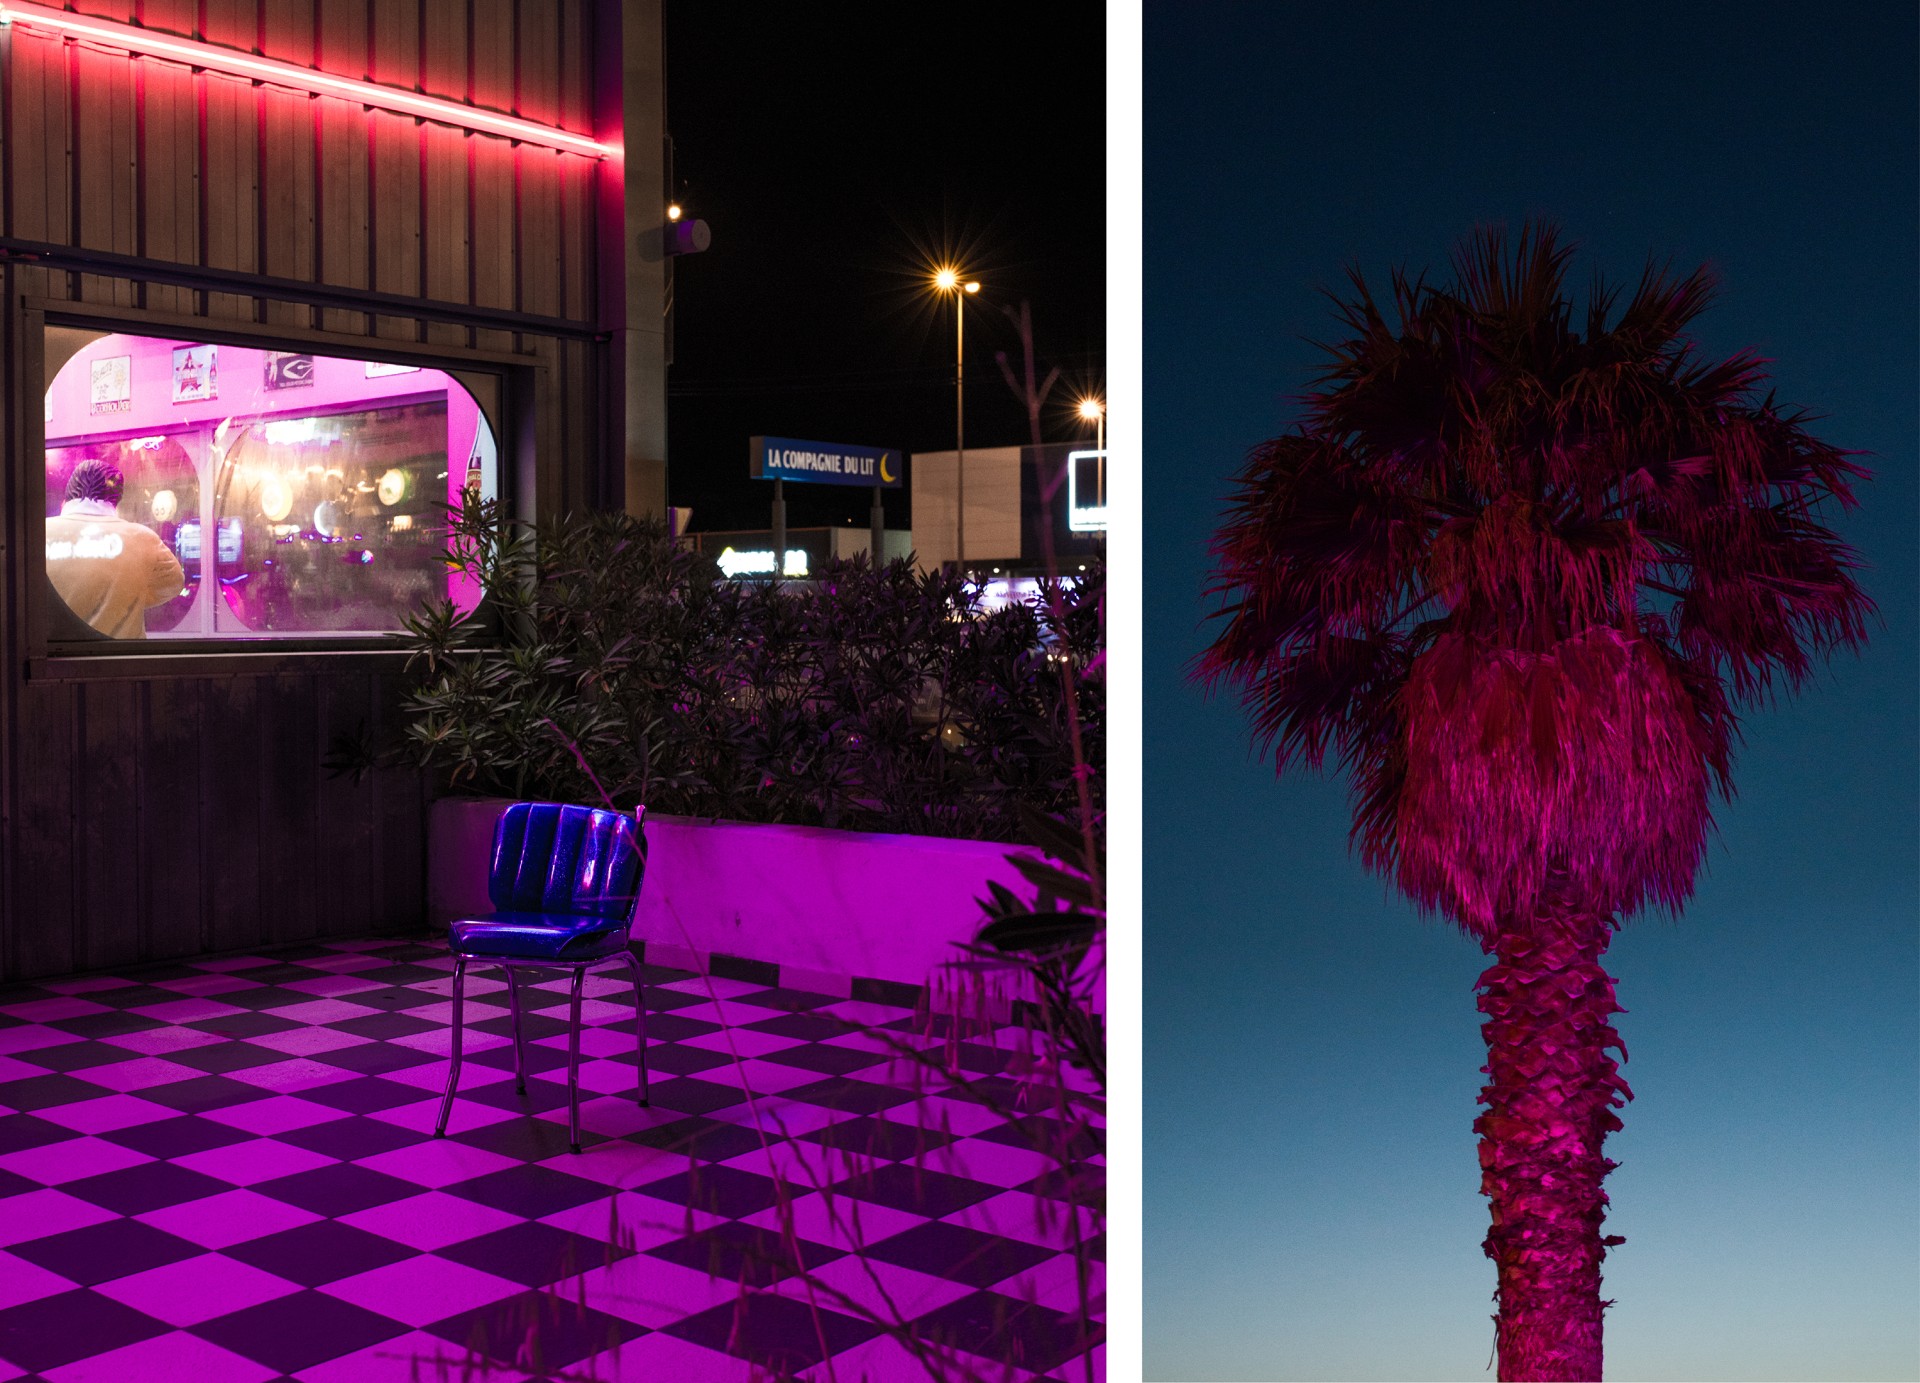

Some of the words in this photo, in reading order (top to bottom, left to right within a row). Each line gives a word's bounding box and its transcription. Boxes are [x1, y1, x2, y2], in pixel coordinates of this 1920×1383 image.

[768, 449, 781, 468] LA
[783, 450, 841, 473] COMPAGNIE
[844, 456, 858, 474] DU
[860, 457, 875, 476] LIT
